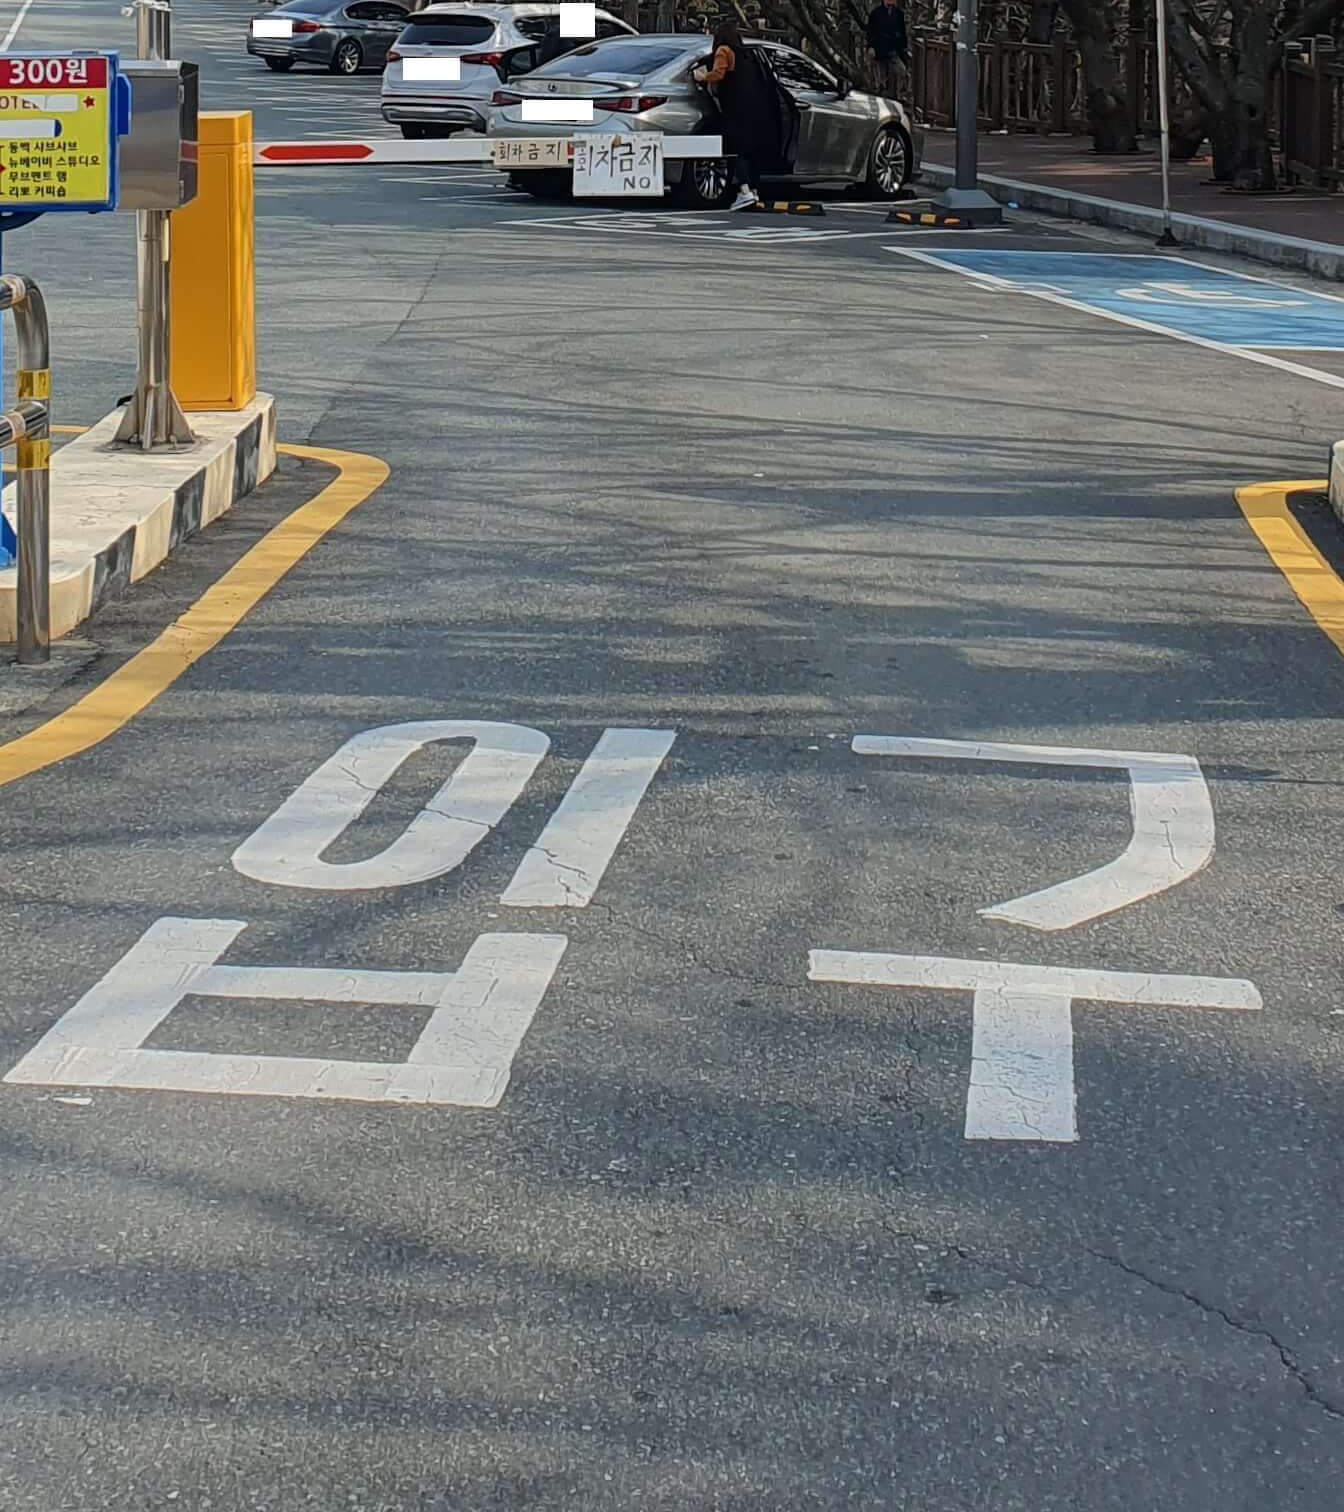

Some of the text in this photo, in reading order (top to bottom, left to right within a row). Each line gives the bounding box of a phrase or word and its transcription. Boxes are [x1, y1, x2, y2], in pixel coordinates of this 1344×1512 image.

[9, 59, 88, 84] 300원
[56, 155, 101, 168] 스튜디오
[575, 141, 657, 178] 회차금지
[623, 176, 651, 191] NO
